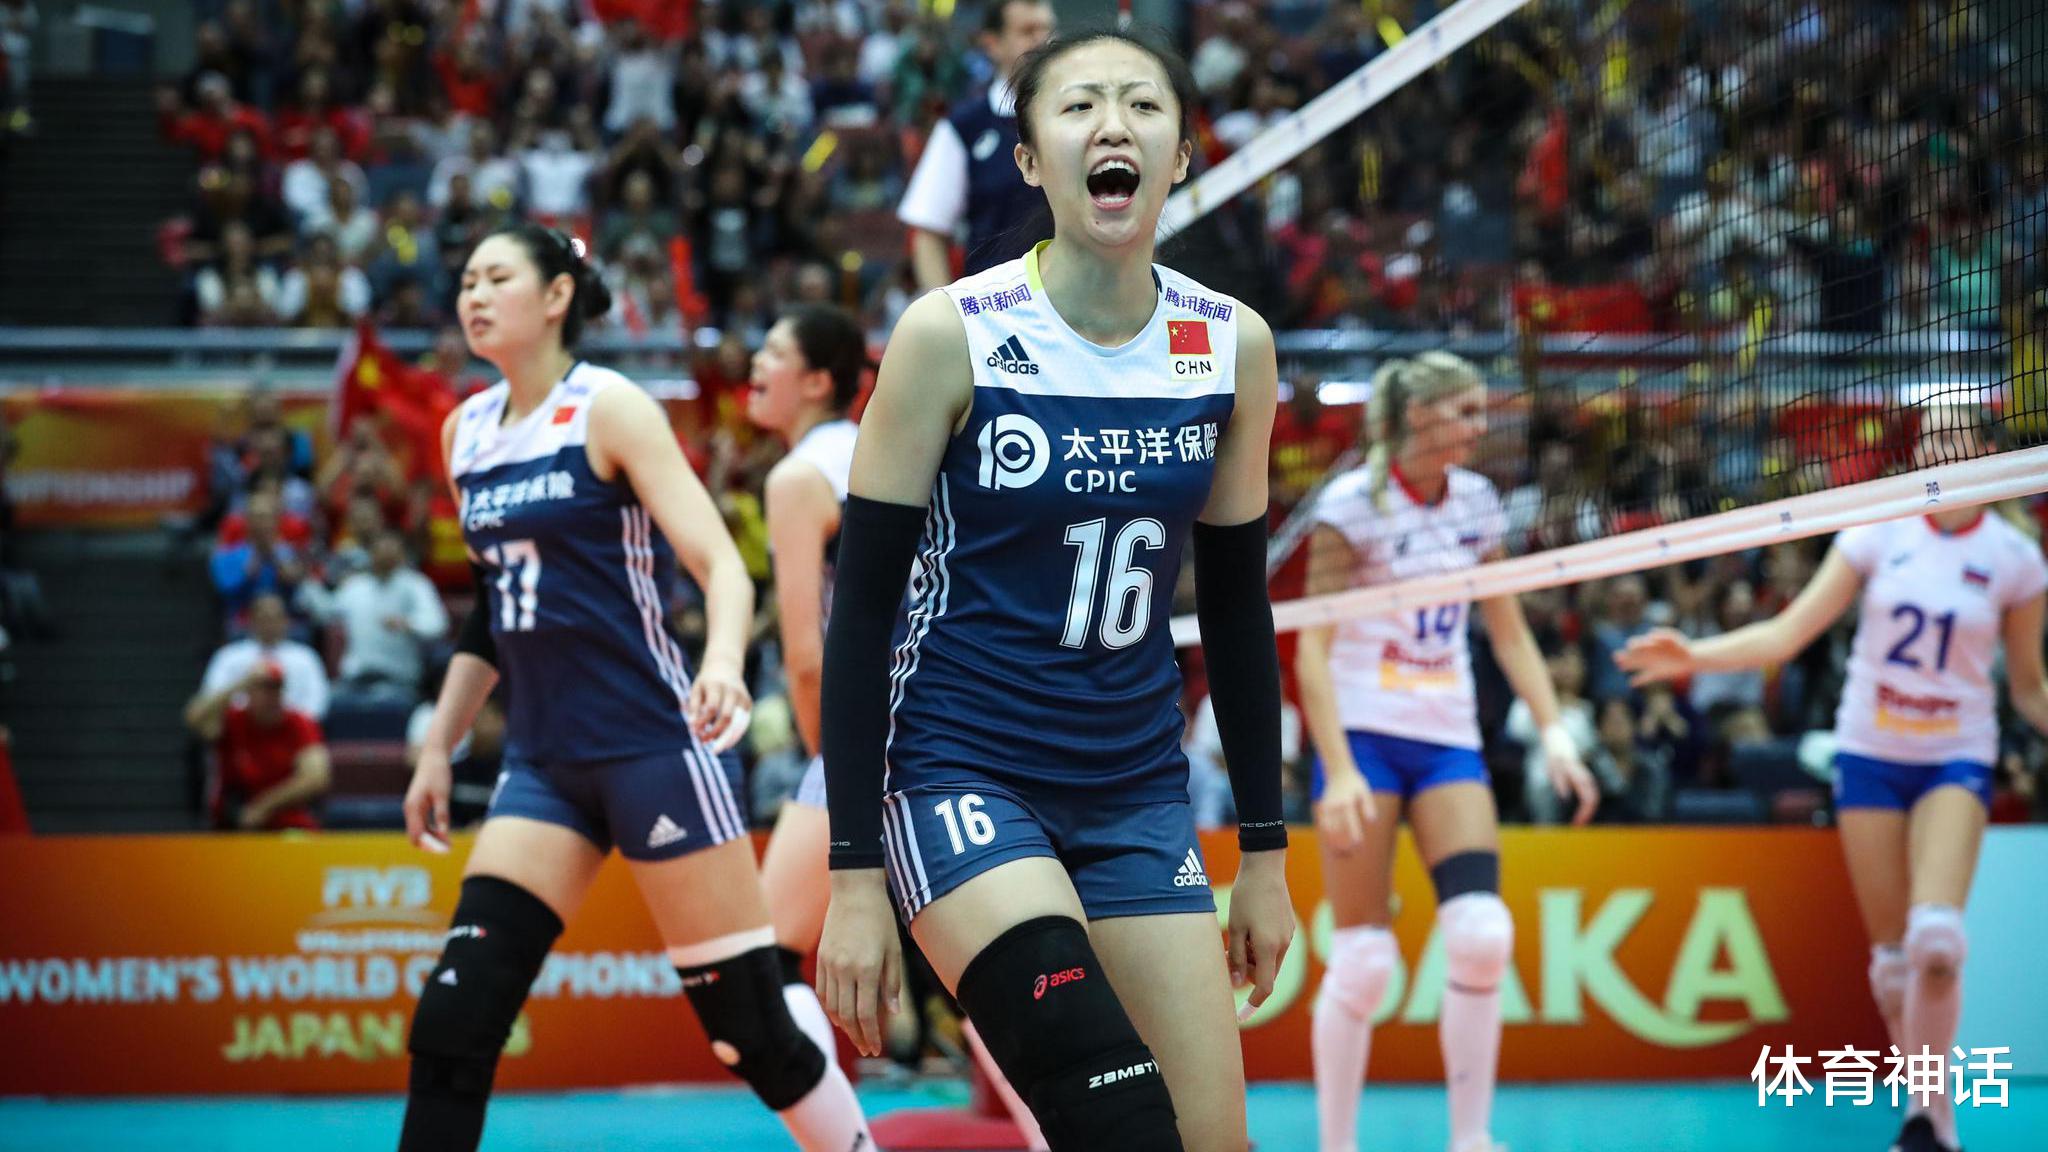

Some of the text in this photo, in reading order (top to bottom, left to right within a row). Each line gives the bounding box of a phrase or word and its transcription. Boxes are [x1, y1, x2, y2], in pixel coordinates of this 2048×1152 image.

[960, 283, 1032, 316] 腾讯新闻
[1165, 287, 1233, 322] 腾讯新闻
[987, 353, 1039, 375] adidas
[1175, 360, 1213, 375] CHN
[1061, 422, 1218, 464] 太平洋保险
[1064, 469, 1137, 493] CPIC
[482, 539, 542, 632] 17
[1059, 517, 1166, 650] 16
[1885, 604, 1957, 672] 21
[934, 793, 996, 856] 16
[1173, 872, 1208, 887] adida
[0, 956, 222, 1003] WOMEN'S
[228, 954, 400, 1002] WORLD
[1050, 967, 1087, 987] asics
[222, 1012, 405, 1063] JAPAN
